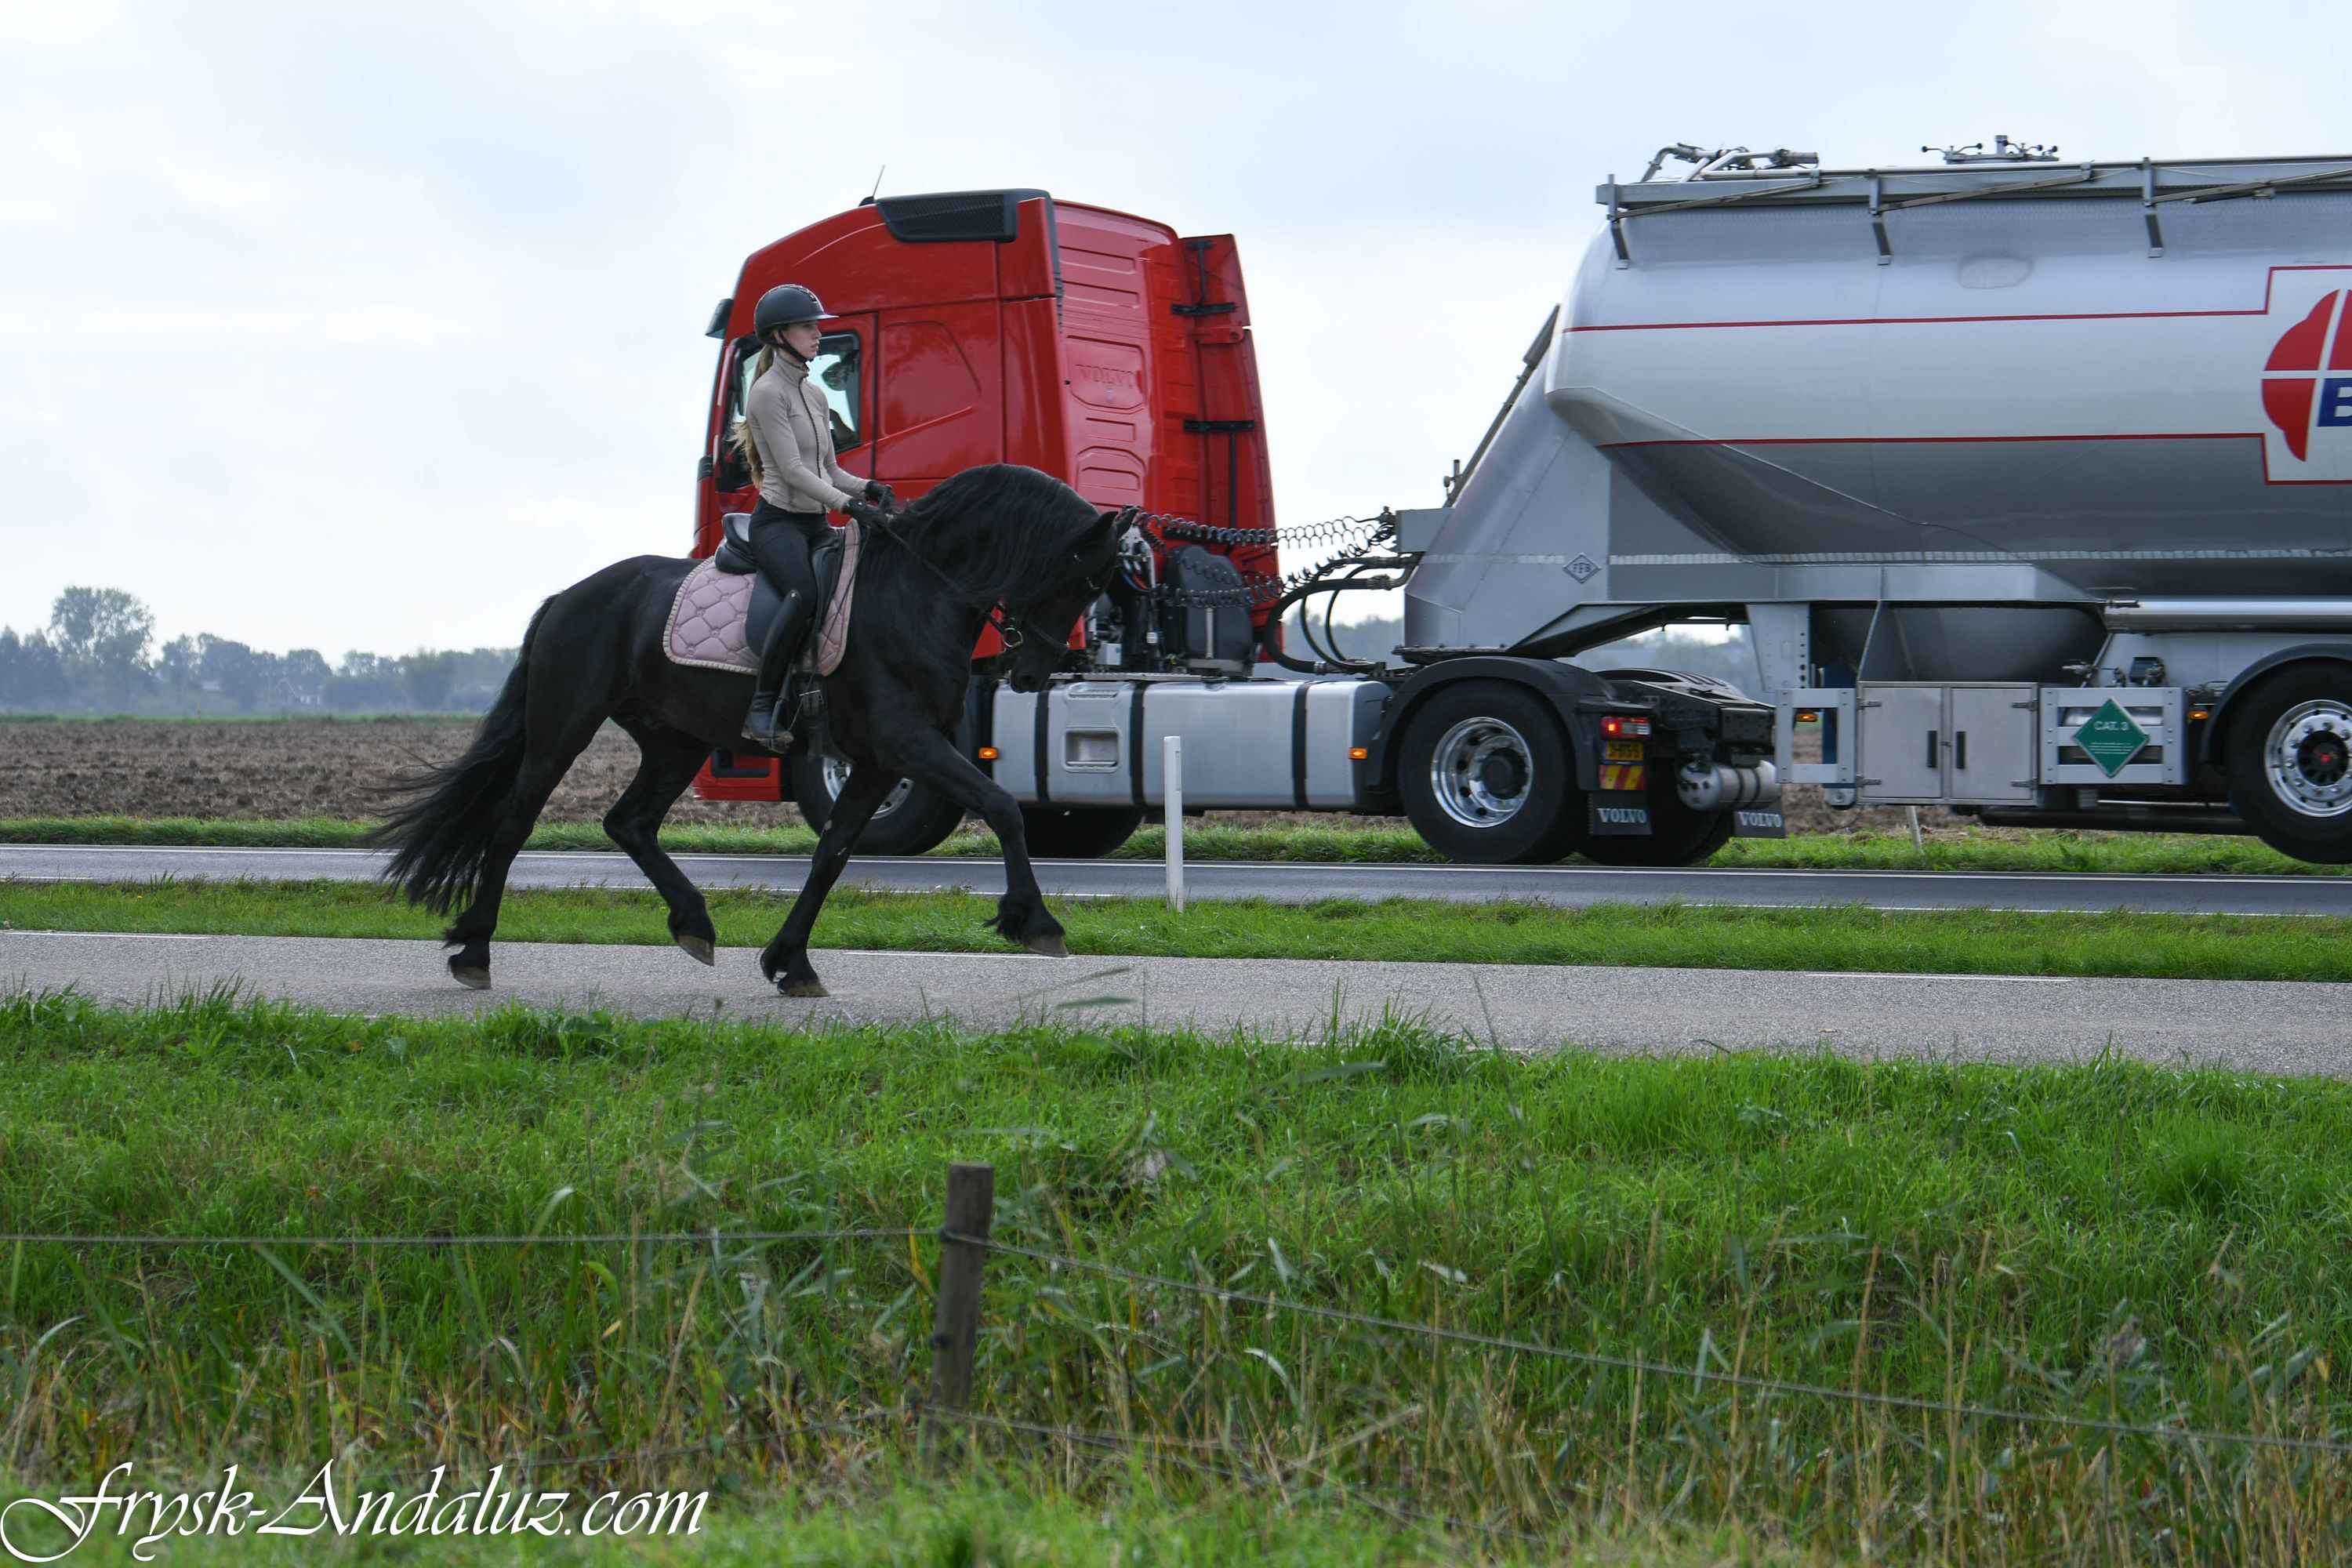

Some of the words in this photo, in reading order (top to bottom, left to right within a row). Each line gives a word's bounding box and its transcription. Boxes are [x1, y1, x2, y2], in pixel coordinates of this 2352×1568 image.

[1075, 364, 1136, 389] VOLVO
[2120, 721, 2129, 731] 3
[1597, 808, 1647, 823] VOLVO
[1738, 811, 1782, 828] VOLVO
